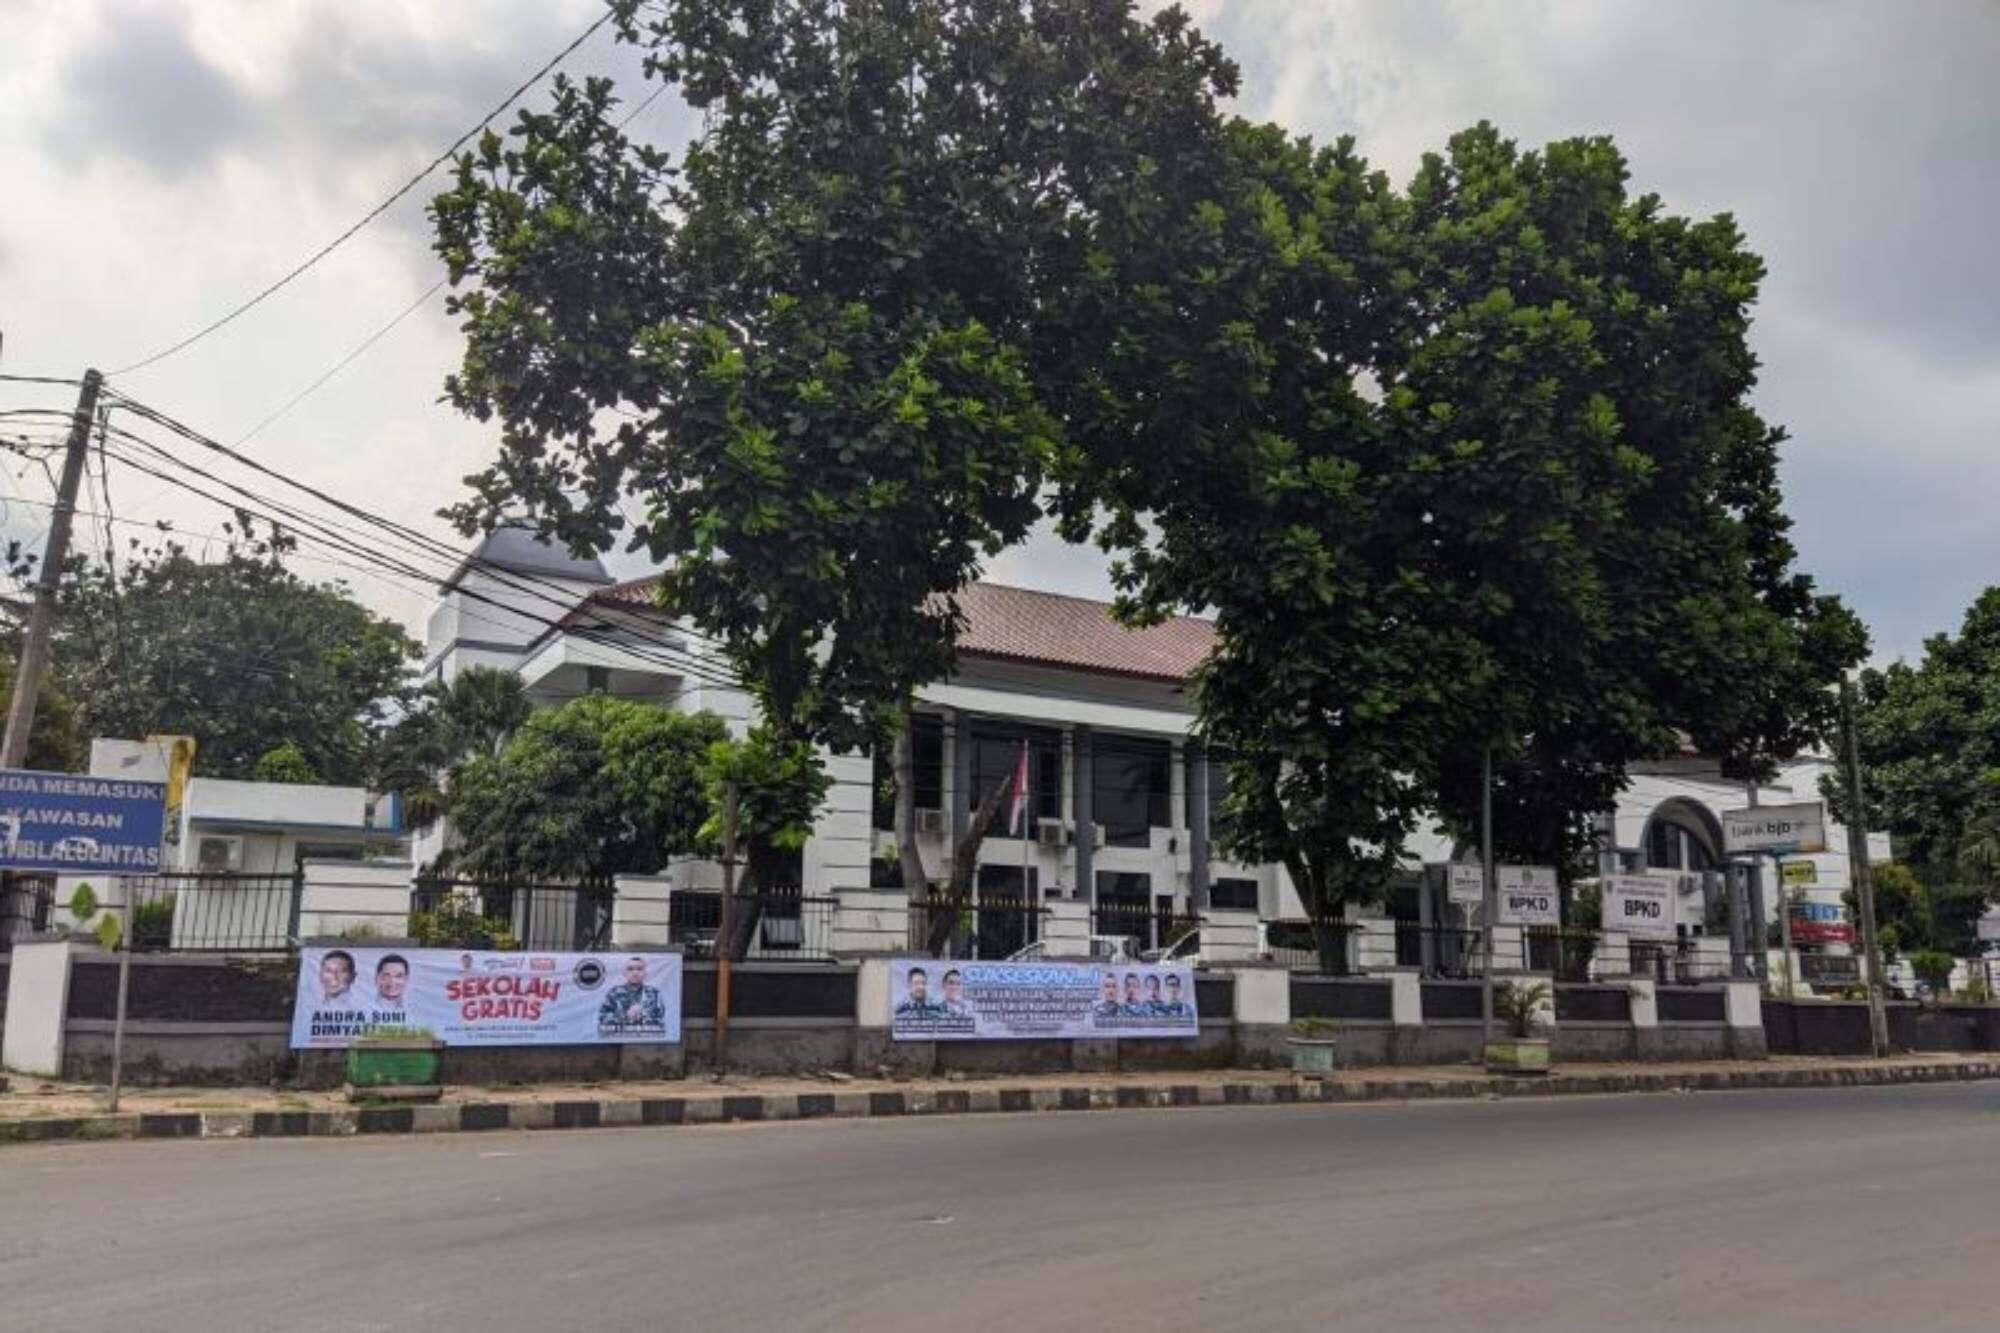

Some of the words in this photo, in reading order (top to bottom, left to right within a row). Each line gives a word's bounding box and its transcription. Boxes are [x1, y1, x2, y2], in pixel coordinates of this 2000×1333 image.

[44, 779, 163, 799] MEMASUKI
[1624, 899, 1661, 918] BPKD
[445, 975, 561, 1001] SEKOLAH
[312, 1010, 365, 1023] ANDRA
[371, 1010, 406, 1023] SONI
[461, 998, 543, 1021] GRATIS
